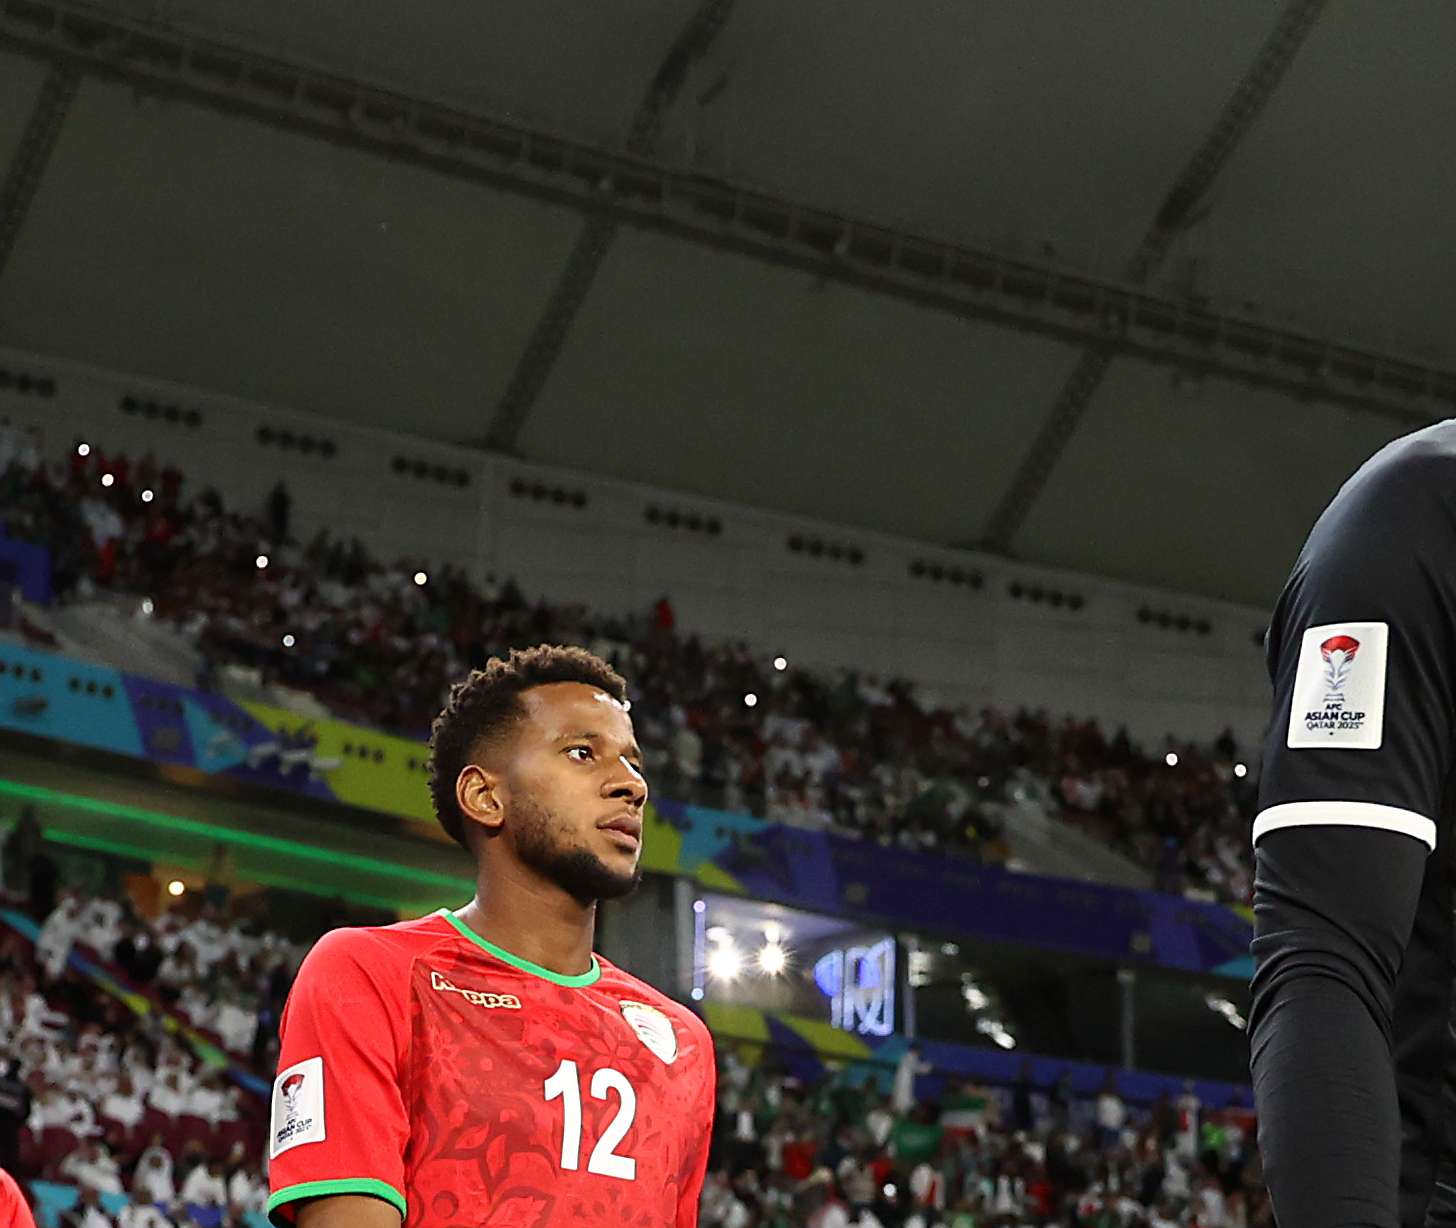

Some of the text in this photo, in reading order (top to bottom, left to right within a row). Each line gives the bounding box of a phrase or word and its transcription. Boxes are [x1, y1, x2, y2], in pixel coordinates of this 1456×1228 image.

[1305, 711, 1366, 721] ASIAN CUP
[1306, 721, 1335, 731] QATAR
[431, 971, 522, 1009] Kppa
[544, 1059, 637, 1181] 12
